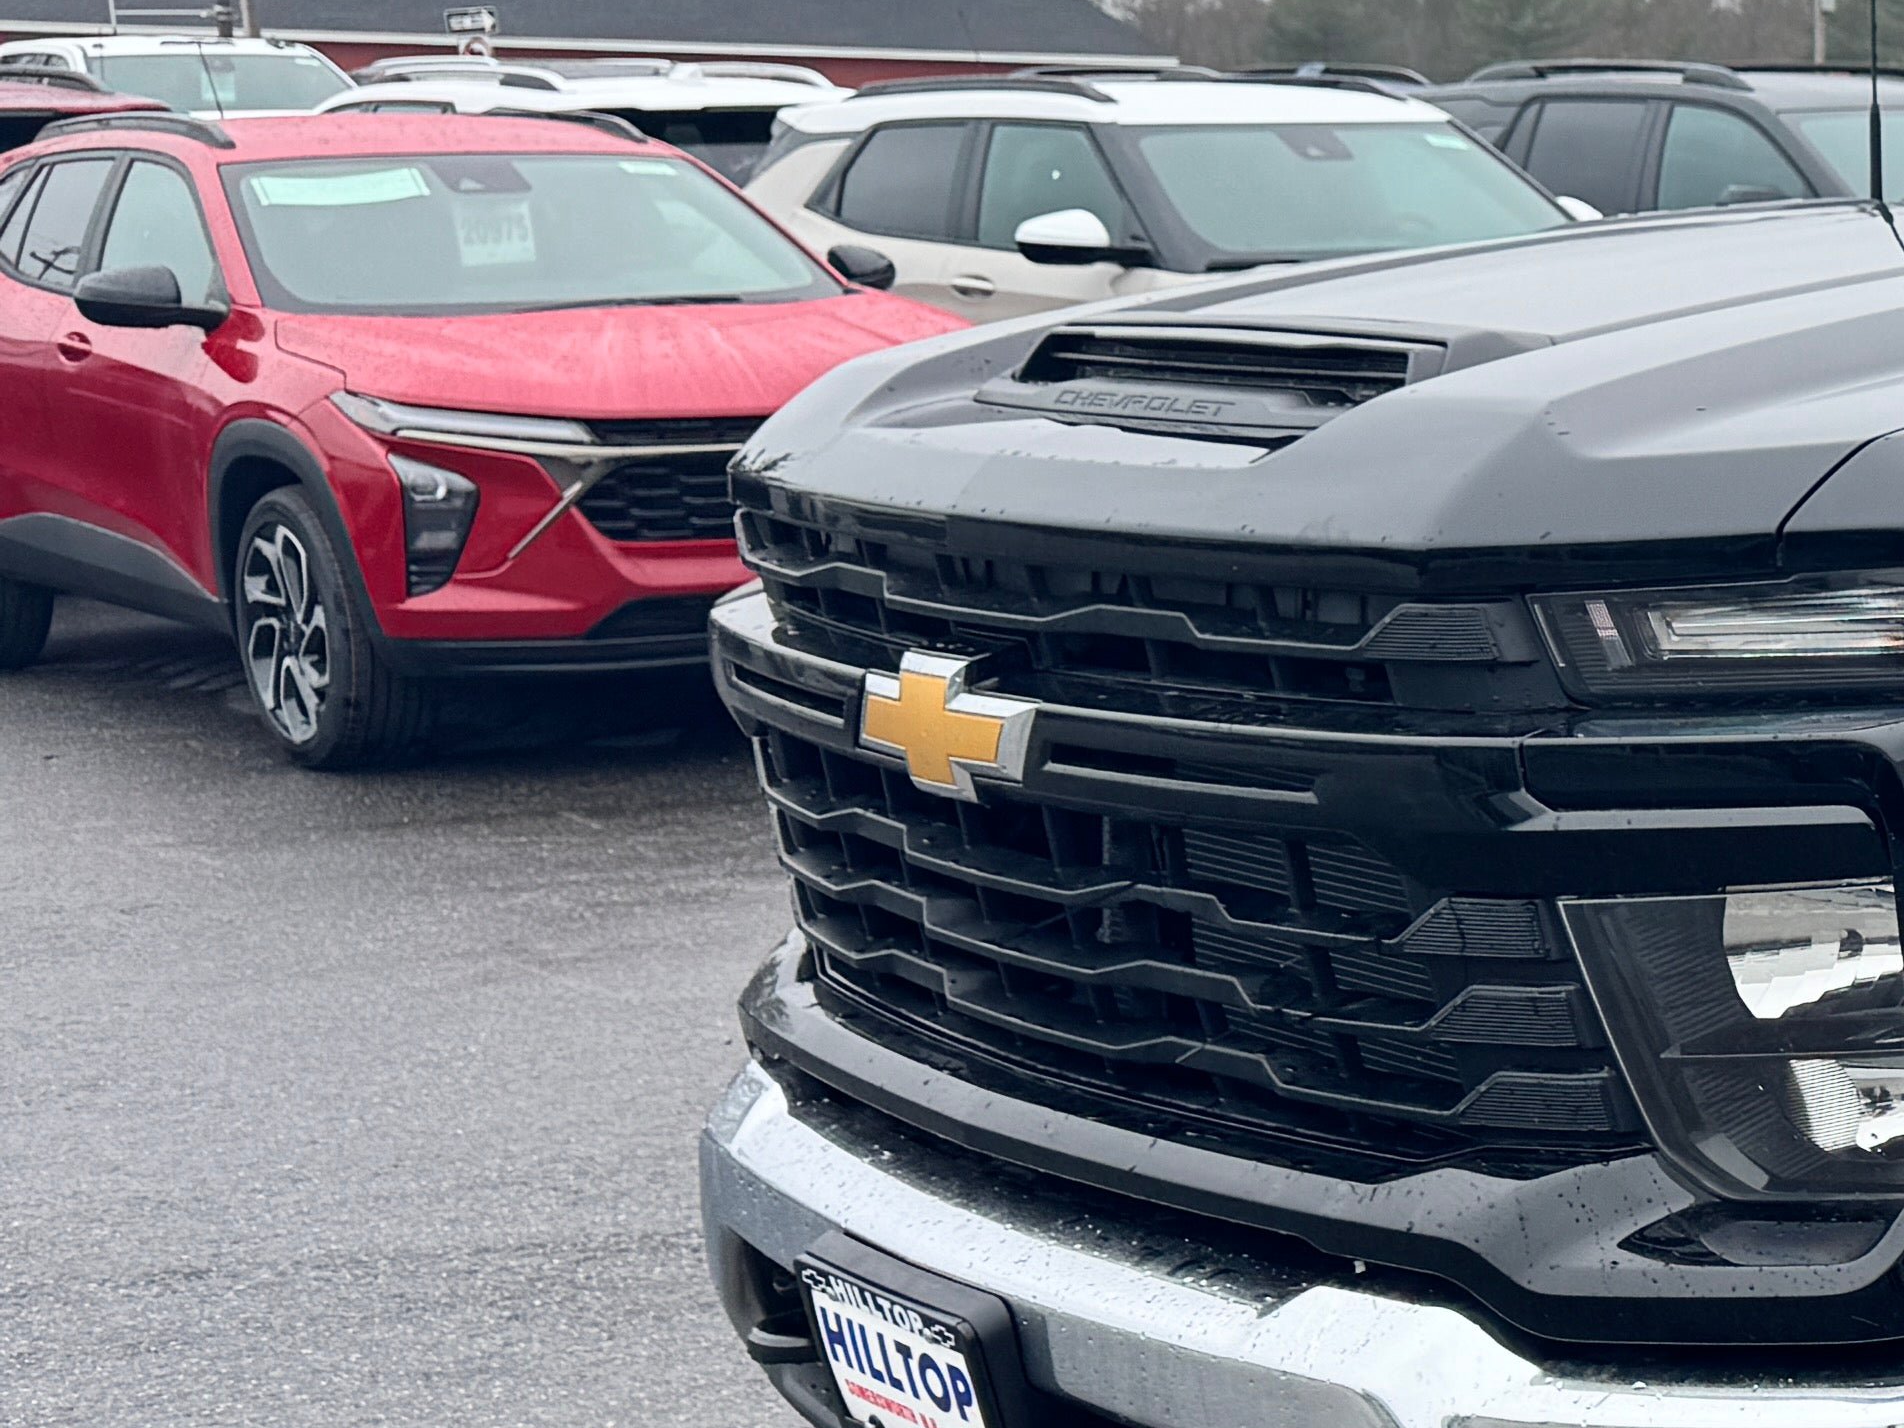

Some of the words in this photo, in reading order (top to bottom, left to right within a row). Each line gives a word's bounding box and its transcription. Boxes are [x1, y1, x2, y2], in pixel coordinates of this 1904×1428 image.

[1054, 389, 1236, 417] CHEVROLET
[829, 1275, 924, 1335] HILLTOP
[820, 1306, 973, 1422] HILLTOP
